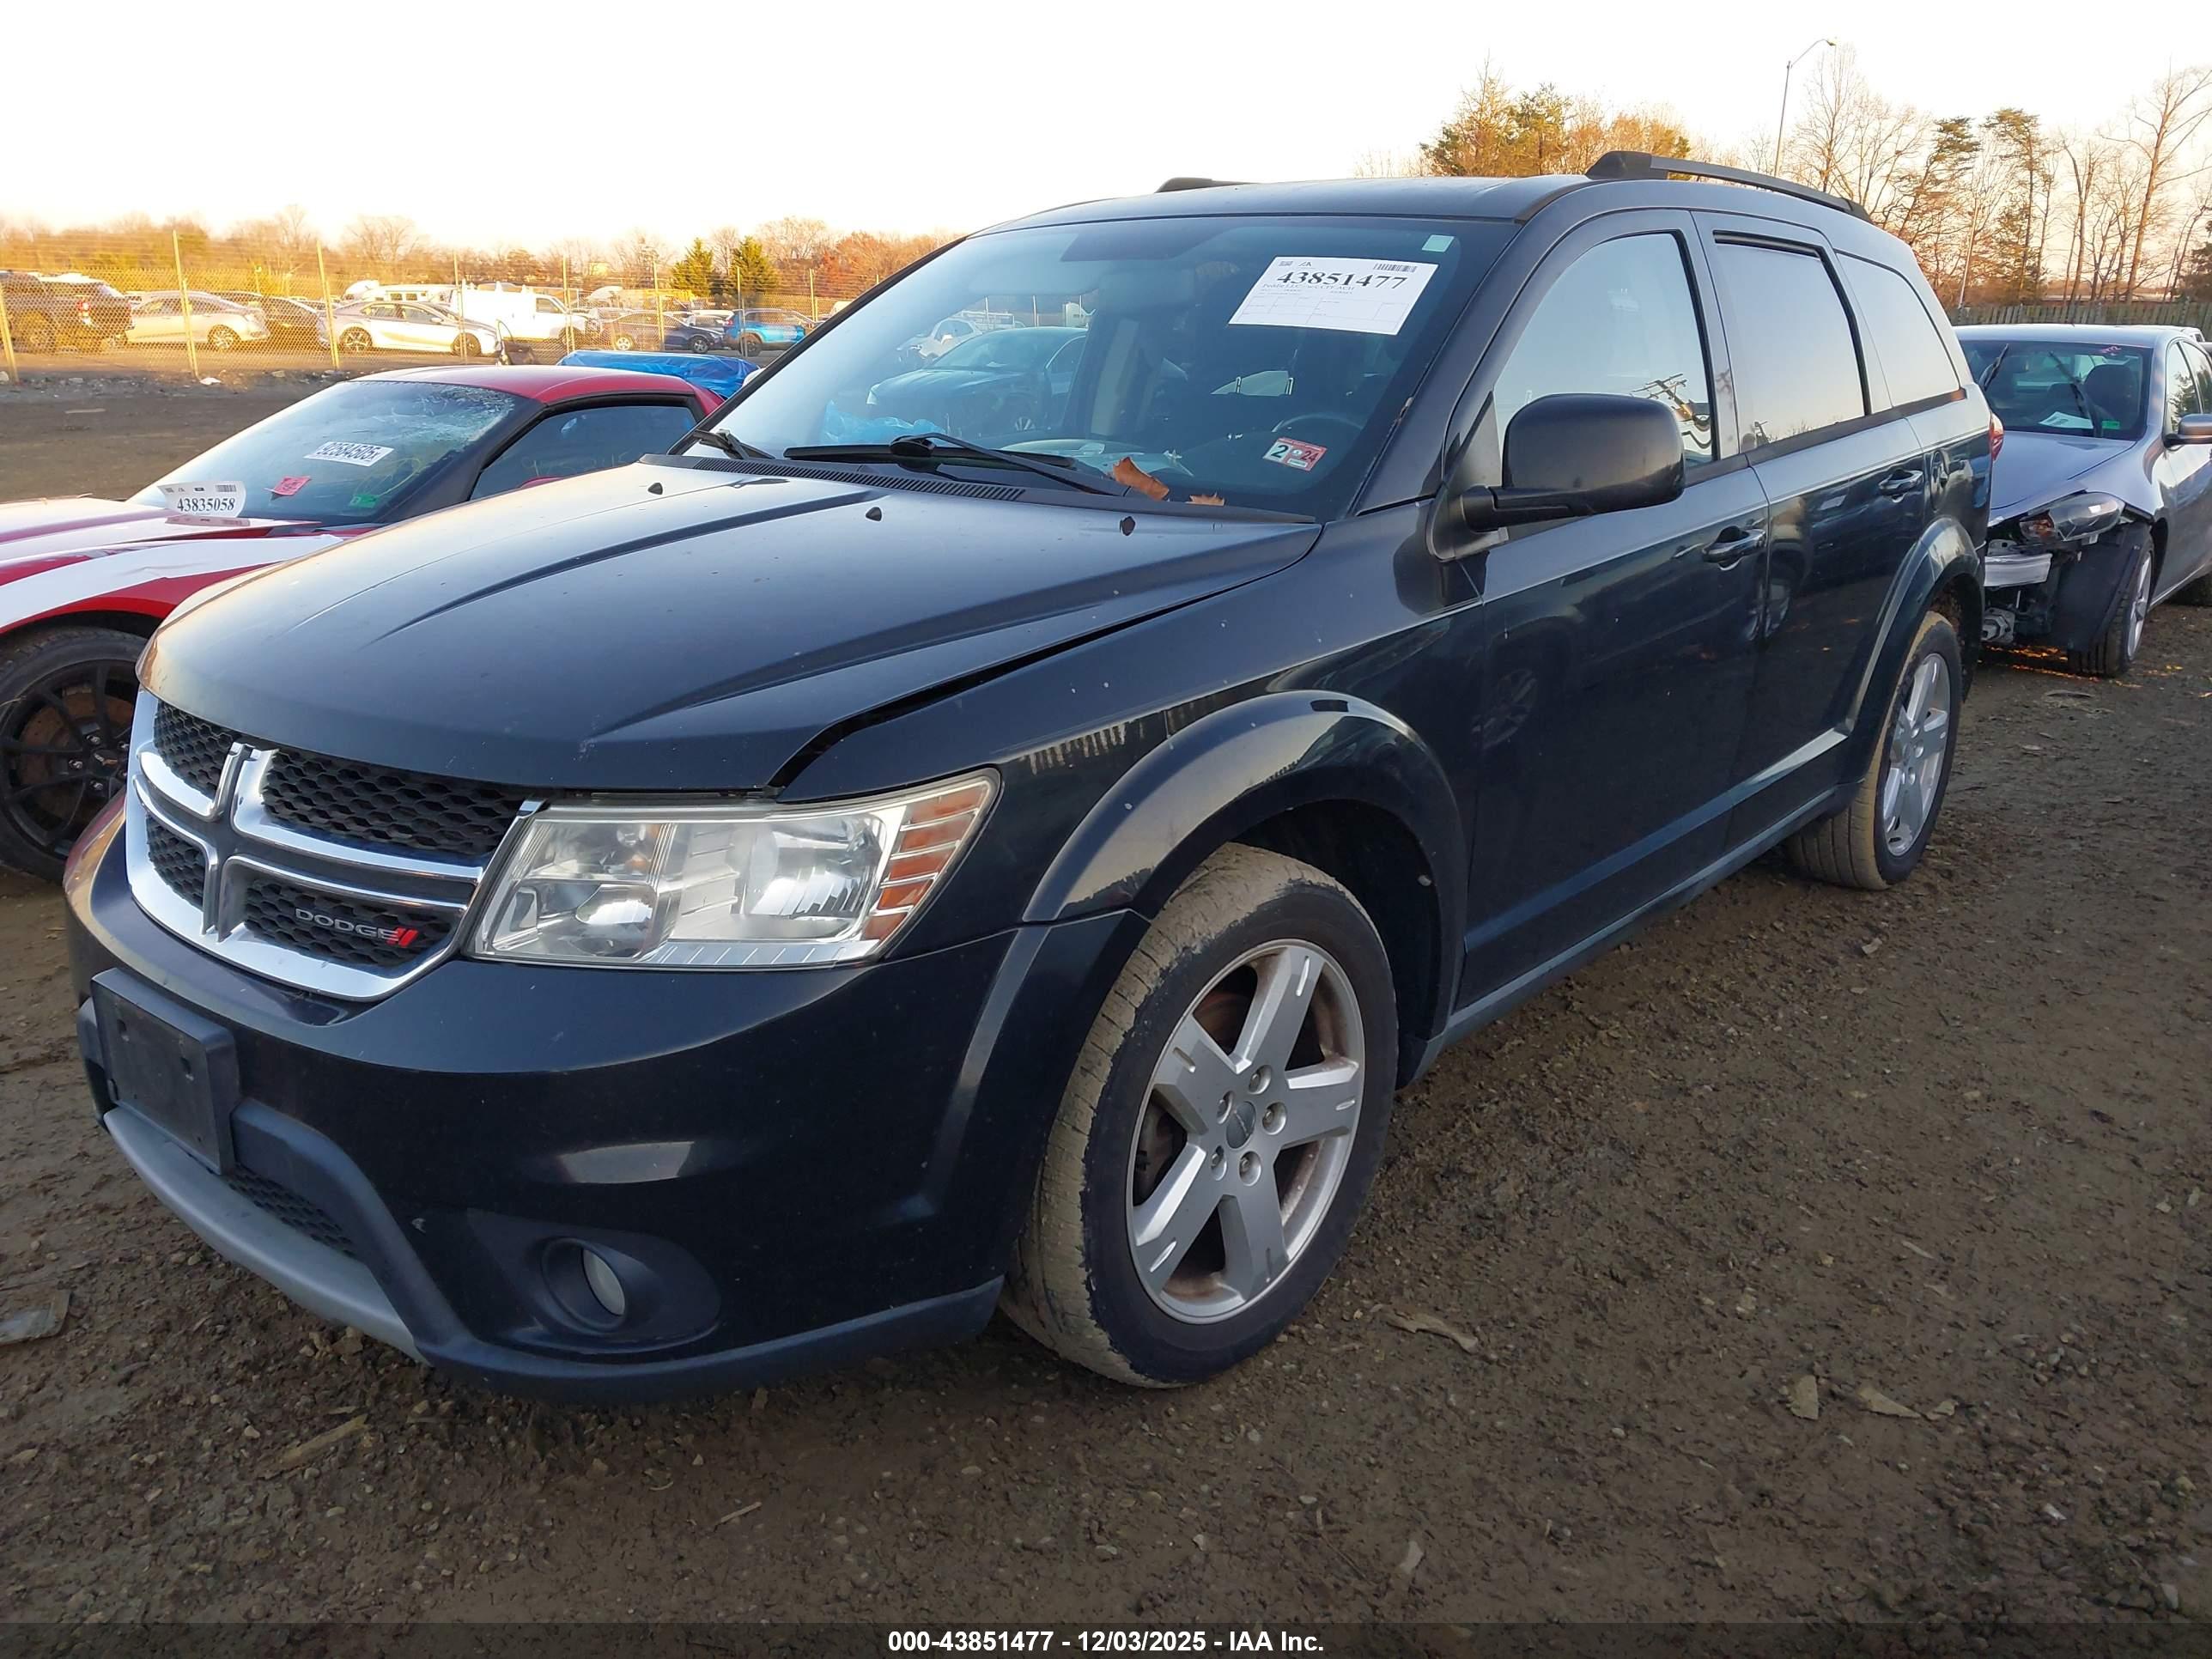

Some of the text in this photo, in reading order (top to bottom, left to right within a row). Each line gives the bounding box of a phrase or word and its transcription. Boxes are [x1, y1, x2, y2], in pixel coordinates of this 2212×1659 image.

[1277, 271, 1408, 289] 43851477
[1270, 444, 1289, 459] 2
[1301, 451, 1319, 463] 24
[177, 497, 236, 513] 43835058
[295, 908, 399, 942] DODGE
